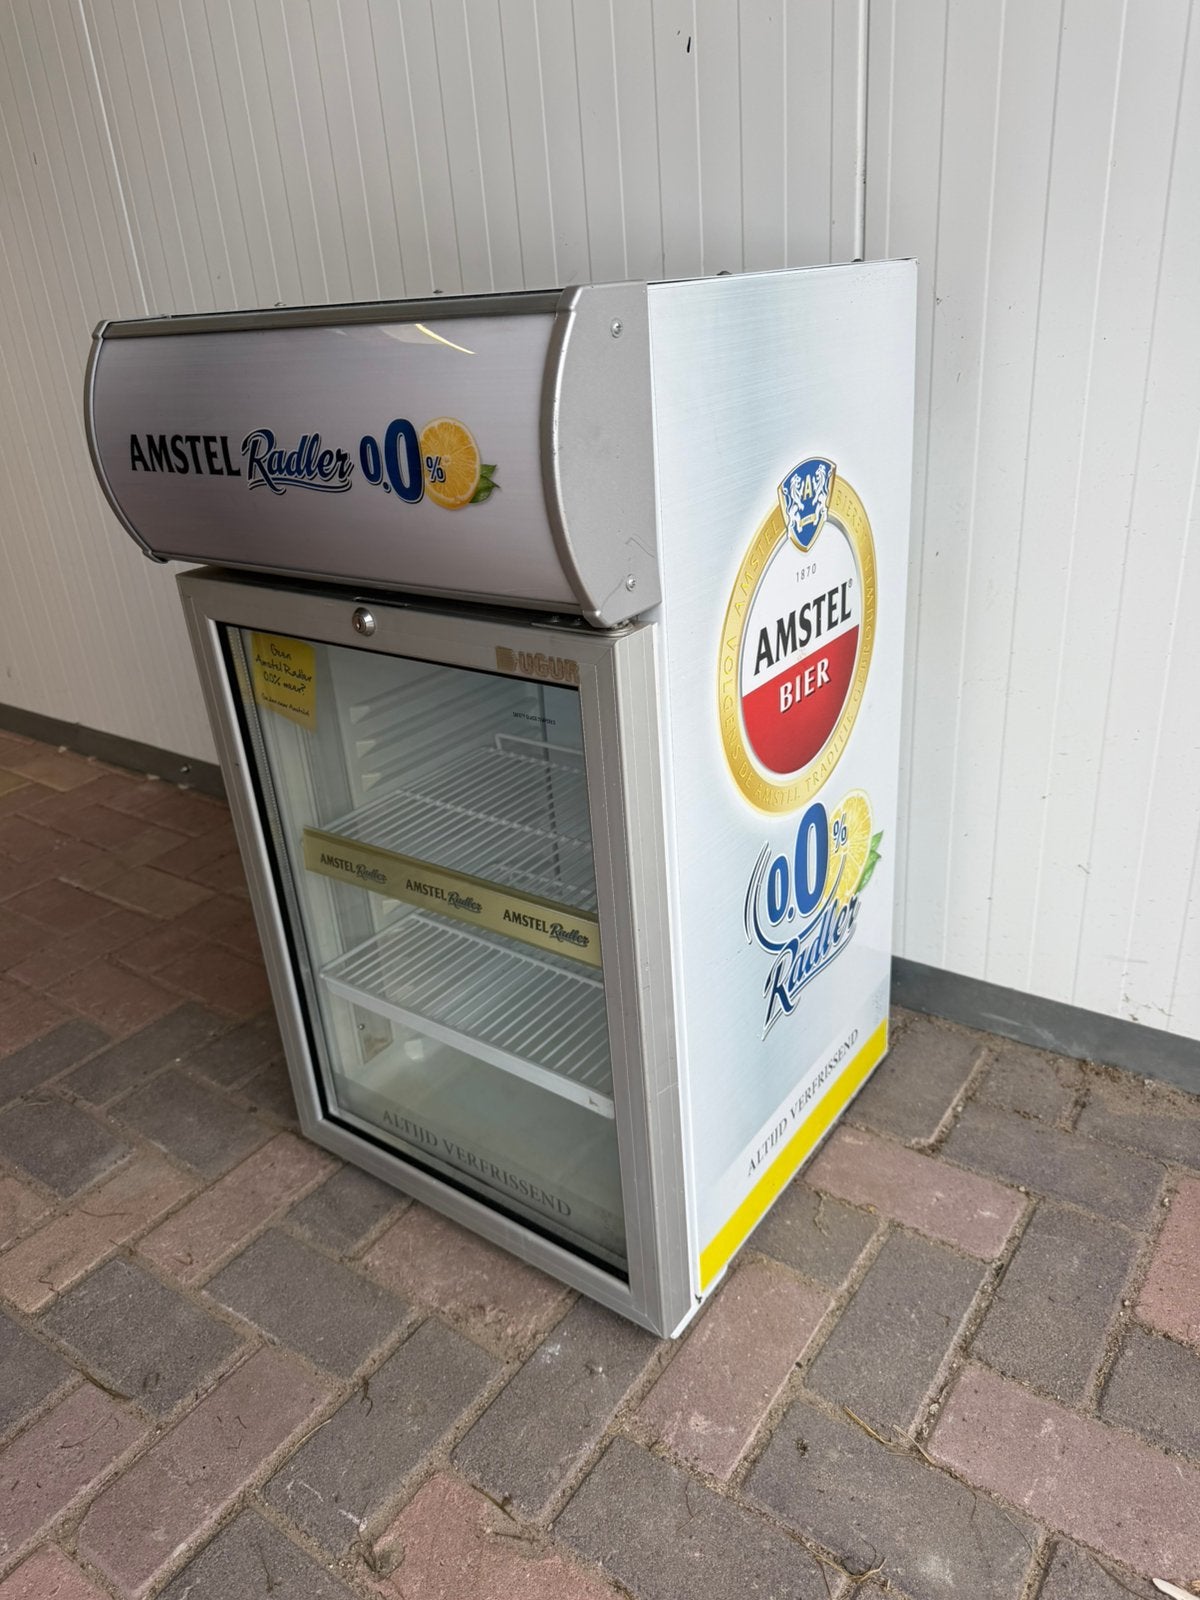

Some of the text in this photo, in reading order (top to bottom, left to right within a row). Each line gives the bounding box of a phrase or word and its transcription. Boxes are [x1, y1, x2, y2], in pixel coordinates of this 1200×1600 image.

[130, 433, 241, 476] AMSTEL
[241, 428, 354, 494] Radler
[796, 562, 817, 583] 1870
[754, 581, 852, 676] AMSTEL
[779, 657, 830, 714] BIER
[320, 853, 590, 948] AMSTEL Radler AMSTEL Radler AMSTEL Radler
[763, 894, 861, 1030] Radler
[748, 1028, 859, 1176] ALTIJD VERFRISSEND
[383, 1109, 572, 1217] ALTIJD VERFRISSEND
